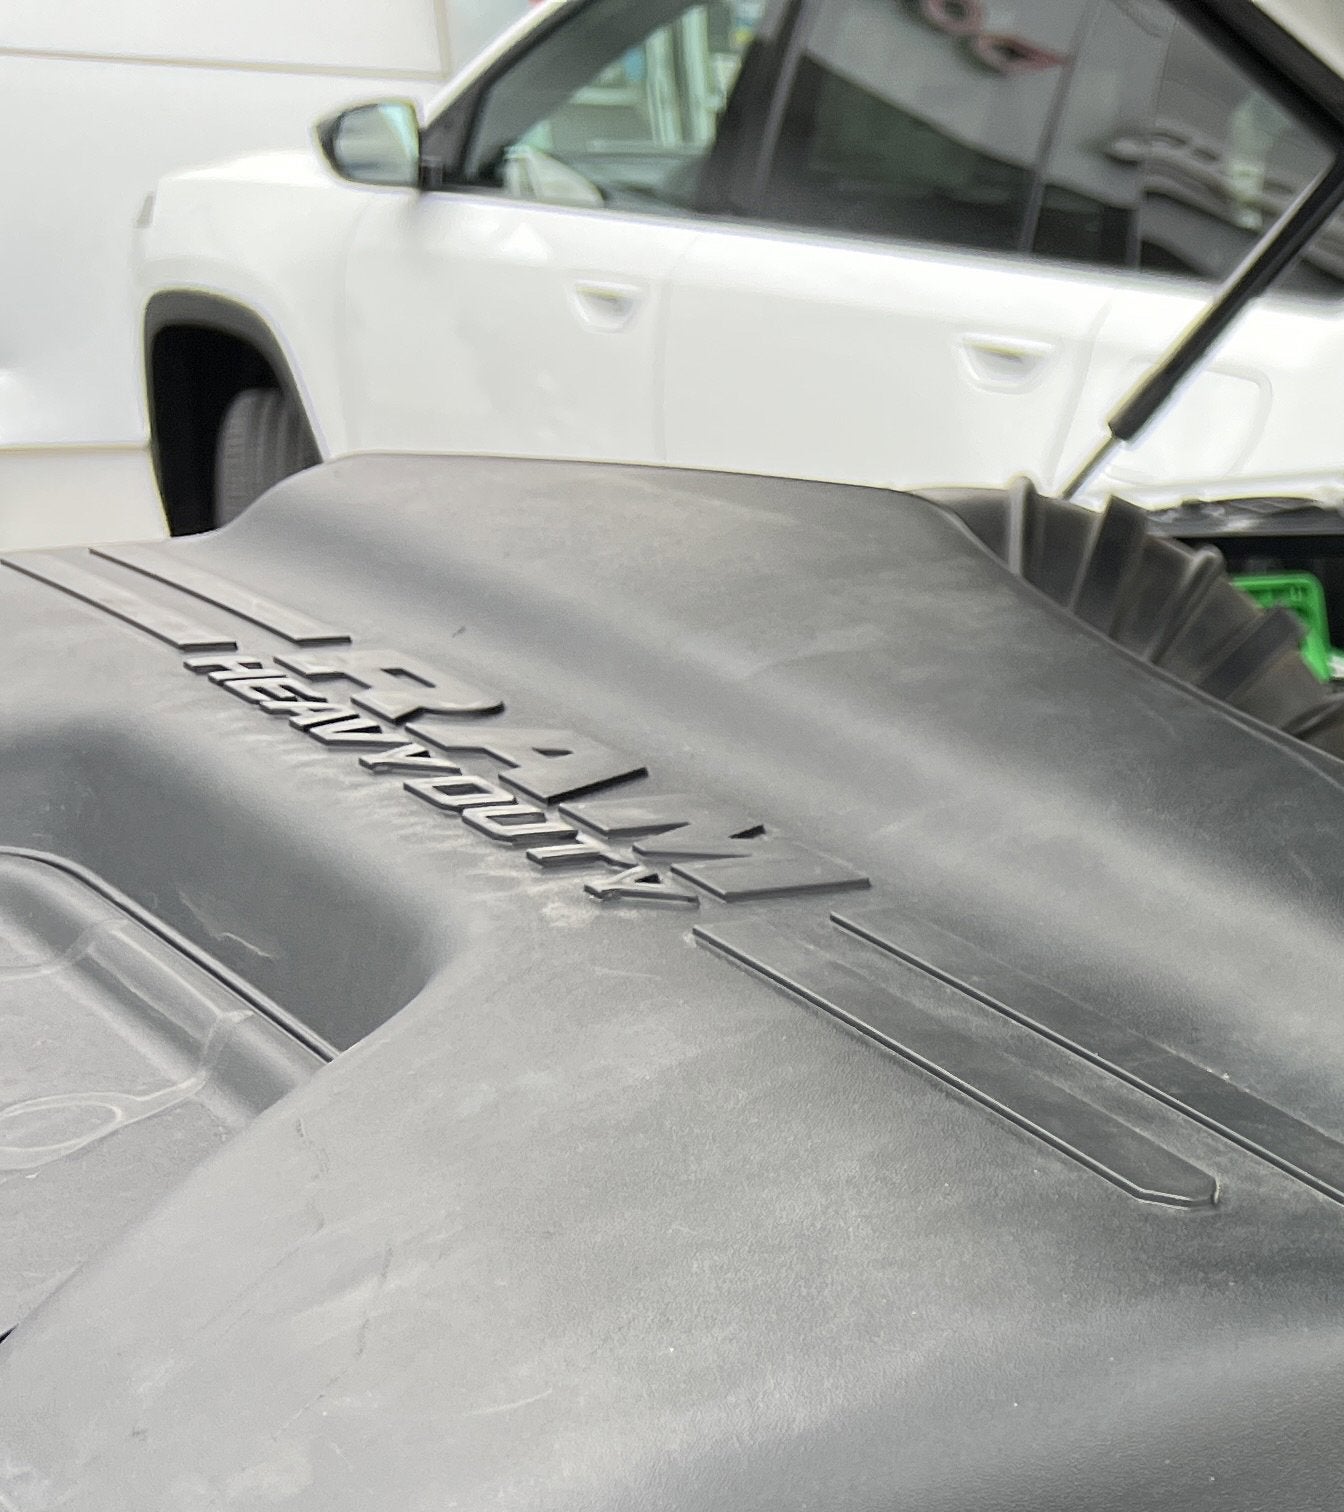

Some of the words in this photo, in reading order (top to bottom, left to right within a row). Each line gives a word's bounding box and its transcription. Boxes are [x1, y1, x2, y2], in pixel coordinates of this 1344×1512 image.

[184, 654, 461, 775] HEAVY
[403, 773, 699, 908] DUTY
[273, 648, 870, 902] RAM
